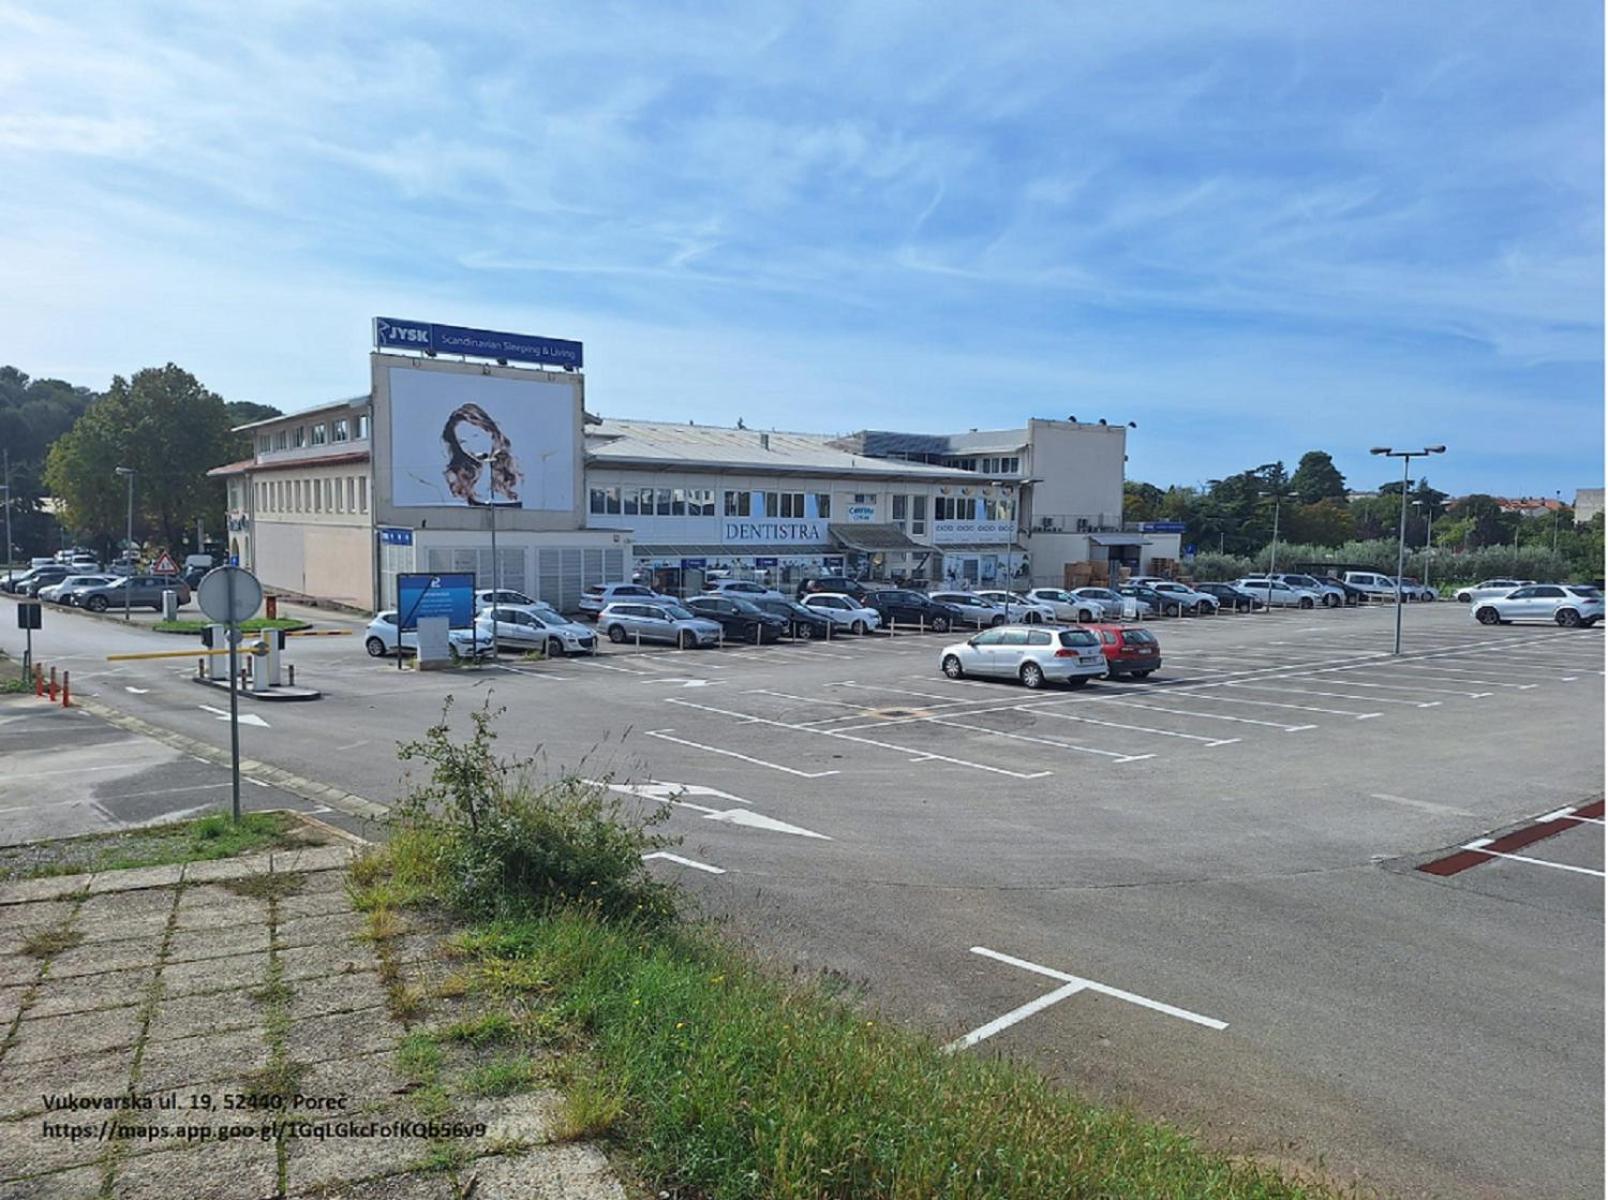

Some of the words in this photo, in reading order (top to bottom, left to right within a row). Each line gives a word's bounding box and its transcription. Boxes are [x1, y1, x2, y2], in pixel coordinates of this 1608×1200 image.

[389, 326, 429, 343] JYSK
[441, 334, 502, 350] Scandinavian
[503, 341, 541, 357] Sleeping
[550, 347, 576, 360] Living
[726, 523, 820, 540] DENTISTRA
